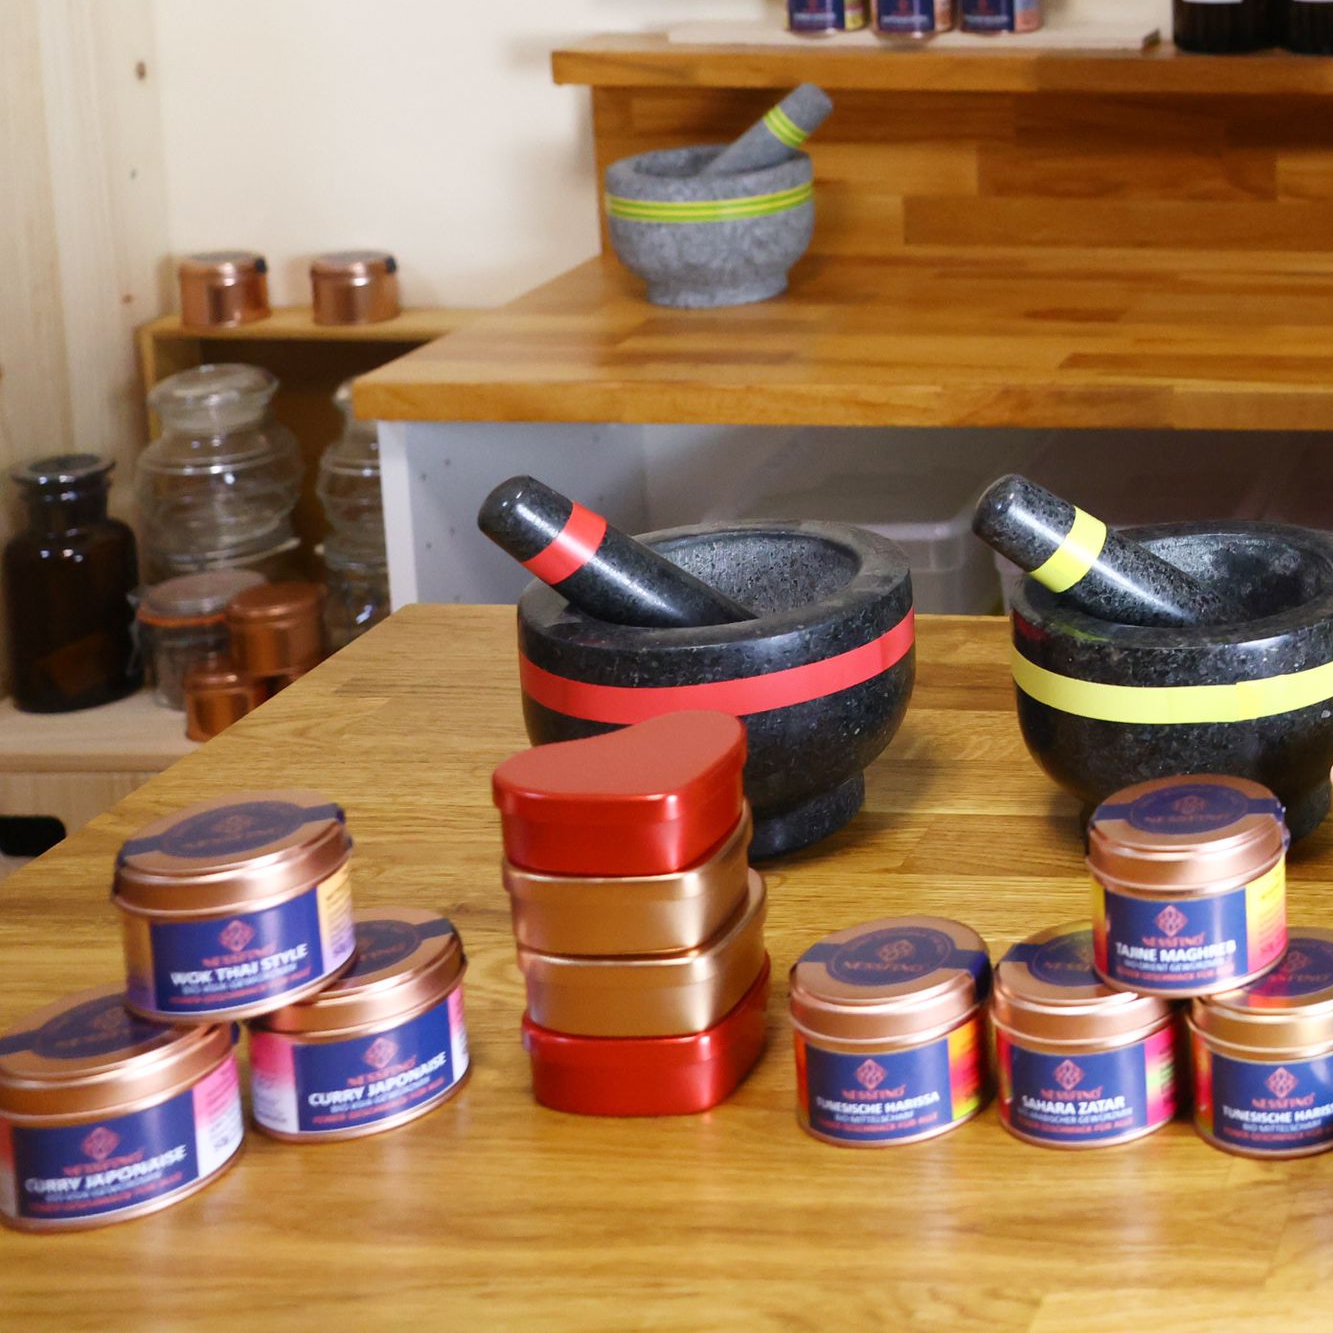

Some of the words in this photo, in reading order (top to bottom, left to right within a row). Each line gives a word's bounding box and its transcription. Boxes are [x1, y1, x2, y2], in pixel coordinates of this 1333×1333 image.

[1115, 942, 1158, 962] TAJINE
[1160, 939, 1237, 963] MAGHREB
[170, 970, 212, 986] WOK
[215, 960, 259, 982] THAI
[260, 943, 308, 970] STYLE
[308, 1086, 366, 1107] CURRY
[368, 1050, 447, 1098] JAPONAISE
[816, 1096, 882, 1115] TUNESISCHE
[884, 1091, 940, 1113] HARISSA
[1022, 1095, 1076, 1115] SAHARA
[1078, 1095, 1126, 1115] ZATAR
[1251, 1092, 1315, 1109] NESSFINO
[1222, 1105, 1292, 1124] TUNESISCHE
[25, 1177, 83, 1194] CURRY
[85, 1144, 188, 1189] JAPONAISE
